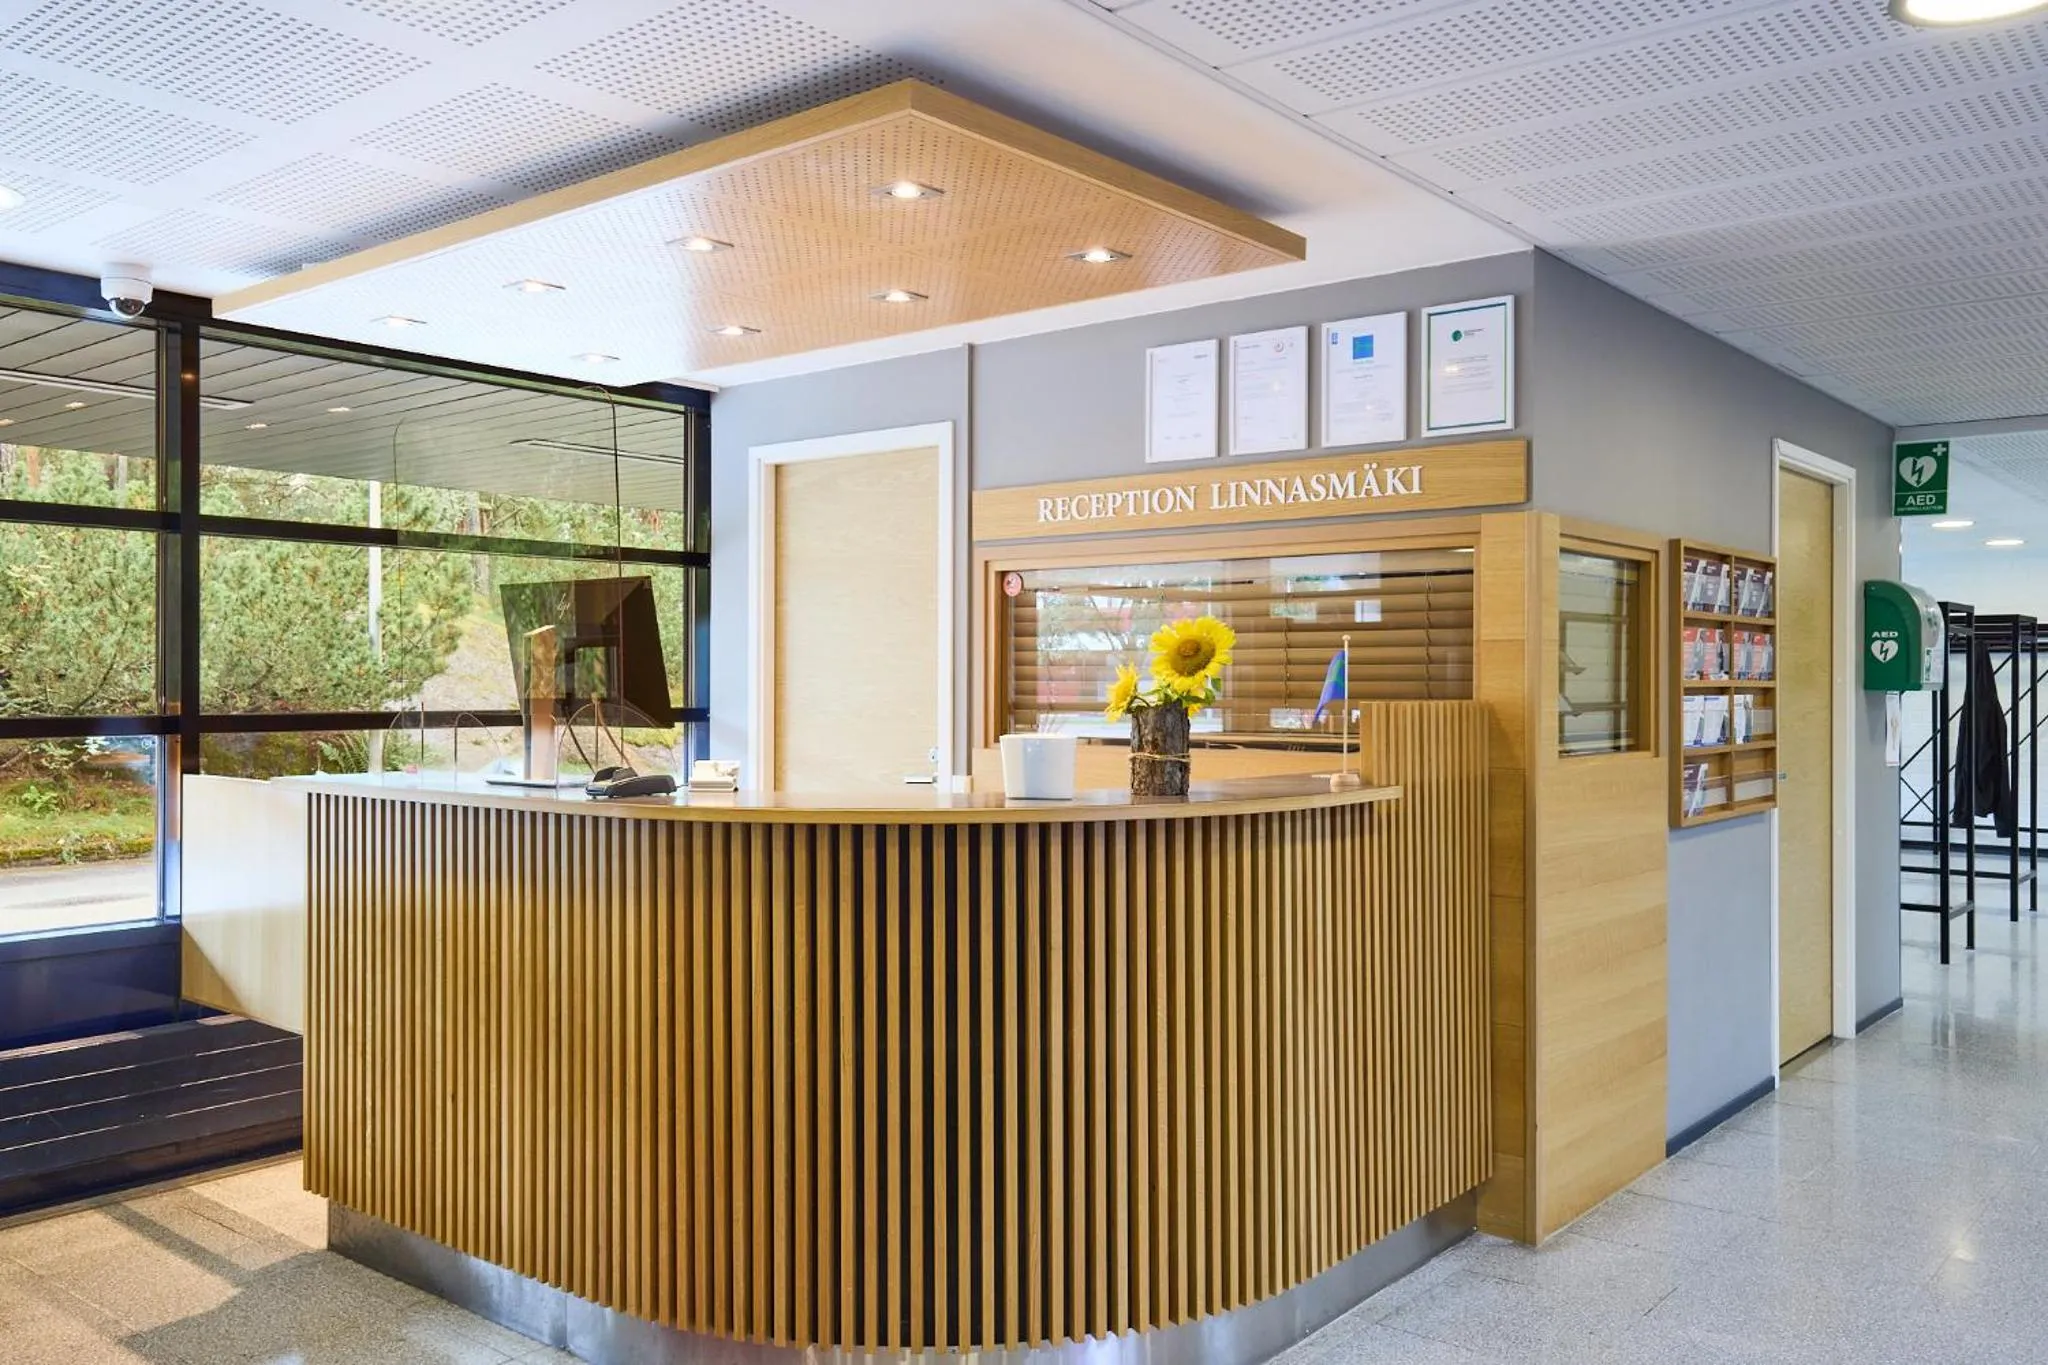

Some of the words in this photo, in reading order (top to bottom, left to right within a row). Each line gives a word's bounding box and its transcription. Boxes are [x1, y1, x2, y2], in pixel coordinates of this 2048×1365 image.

[1038, 486, 1197, 523] RECEPTION
[1209, 462, 1424, 510] LINNASMÄKI
[1904, 494, 1936, 506] AED
[1871, 631, 1899, 639] AED
